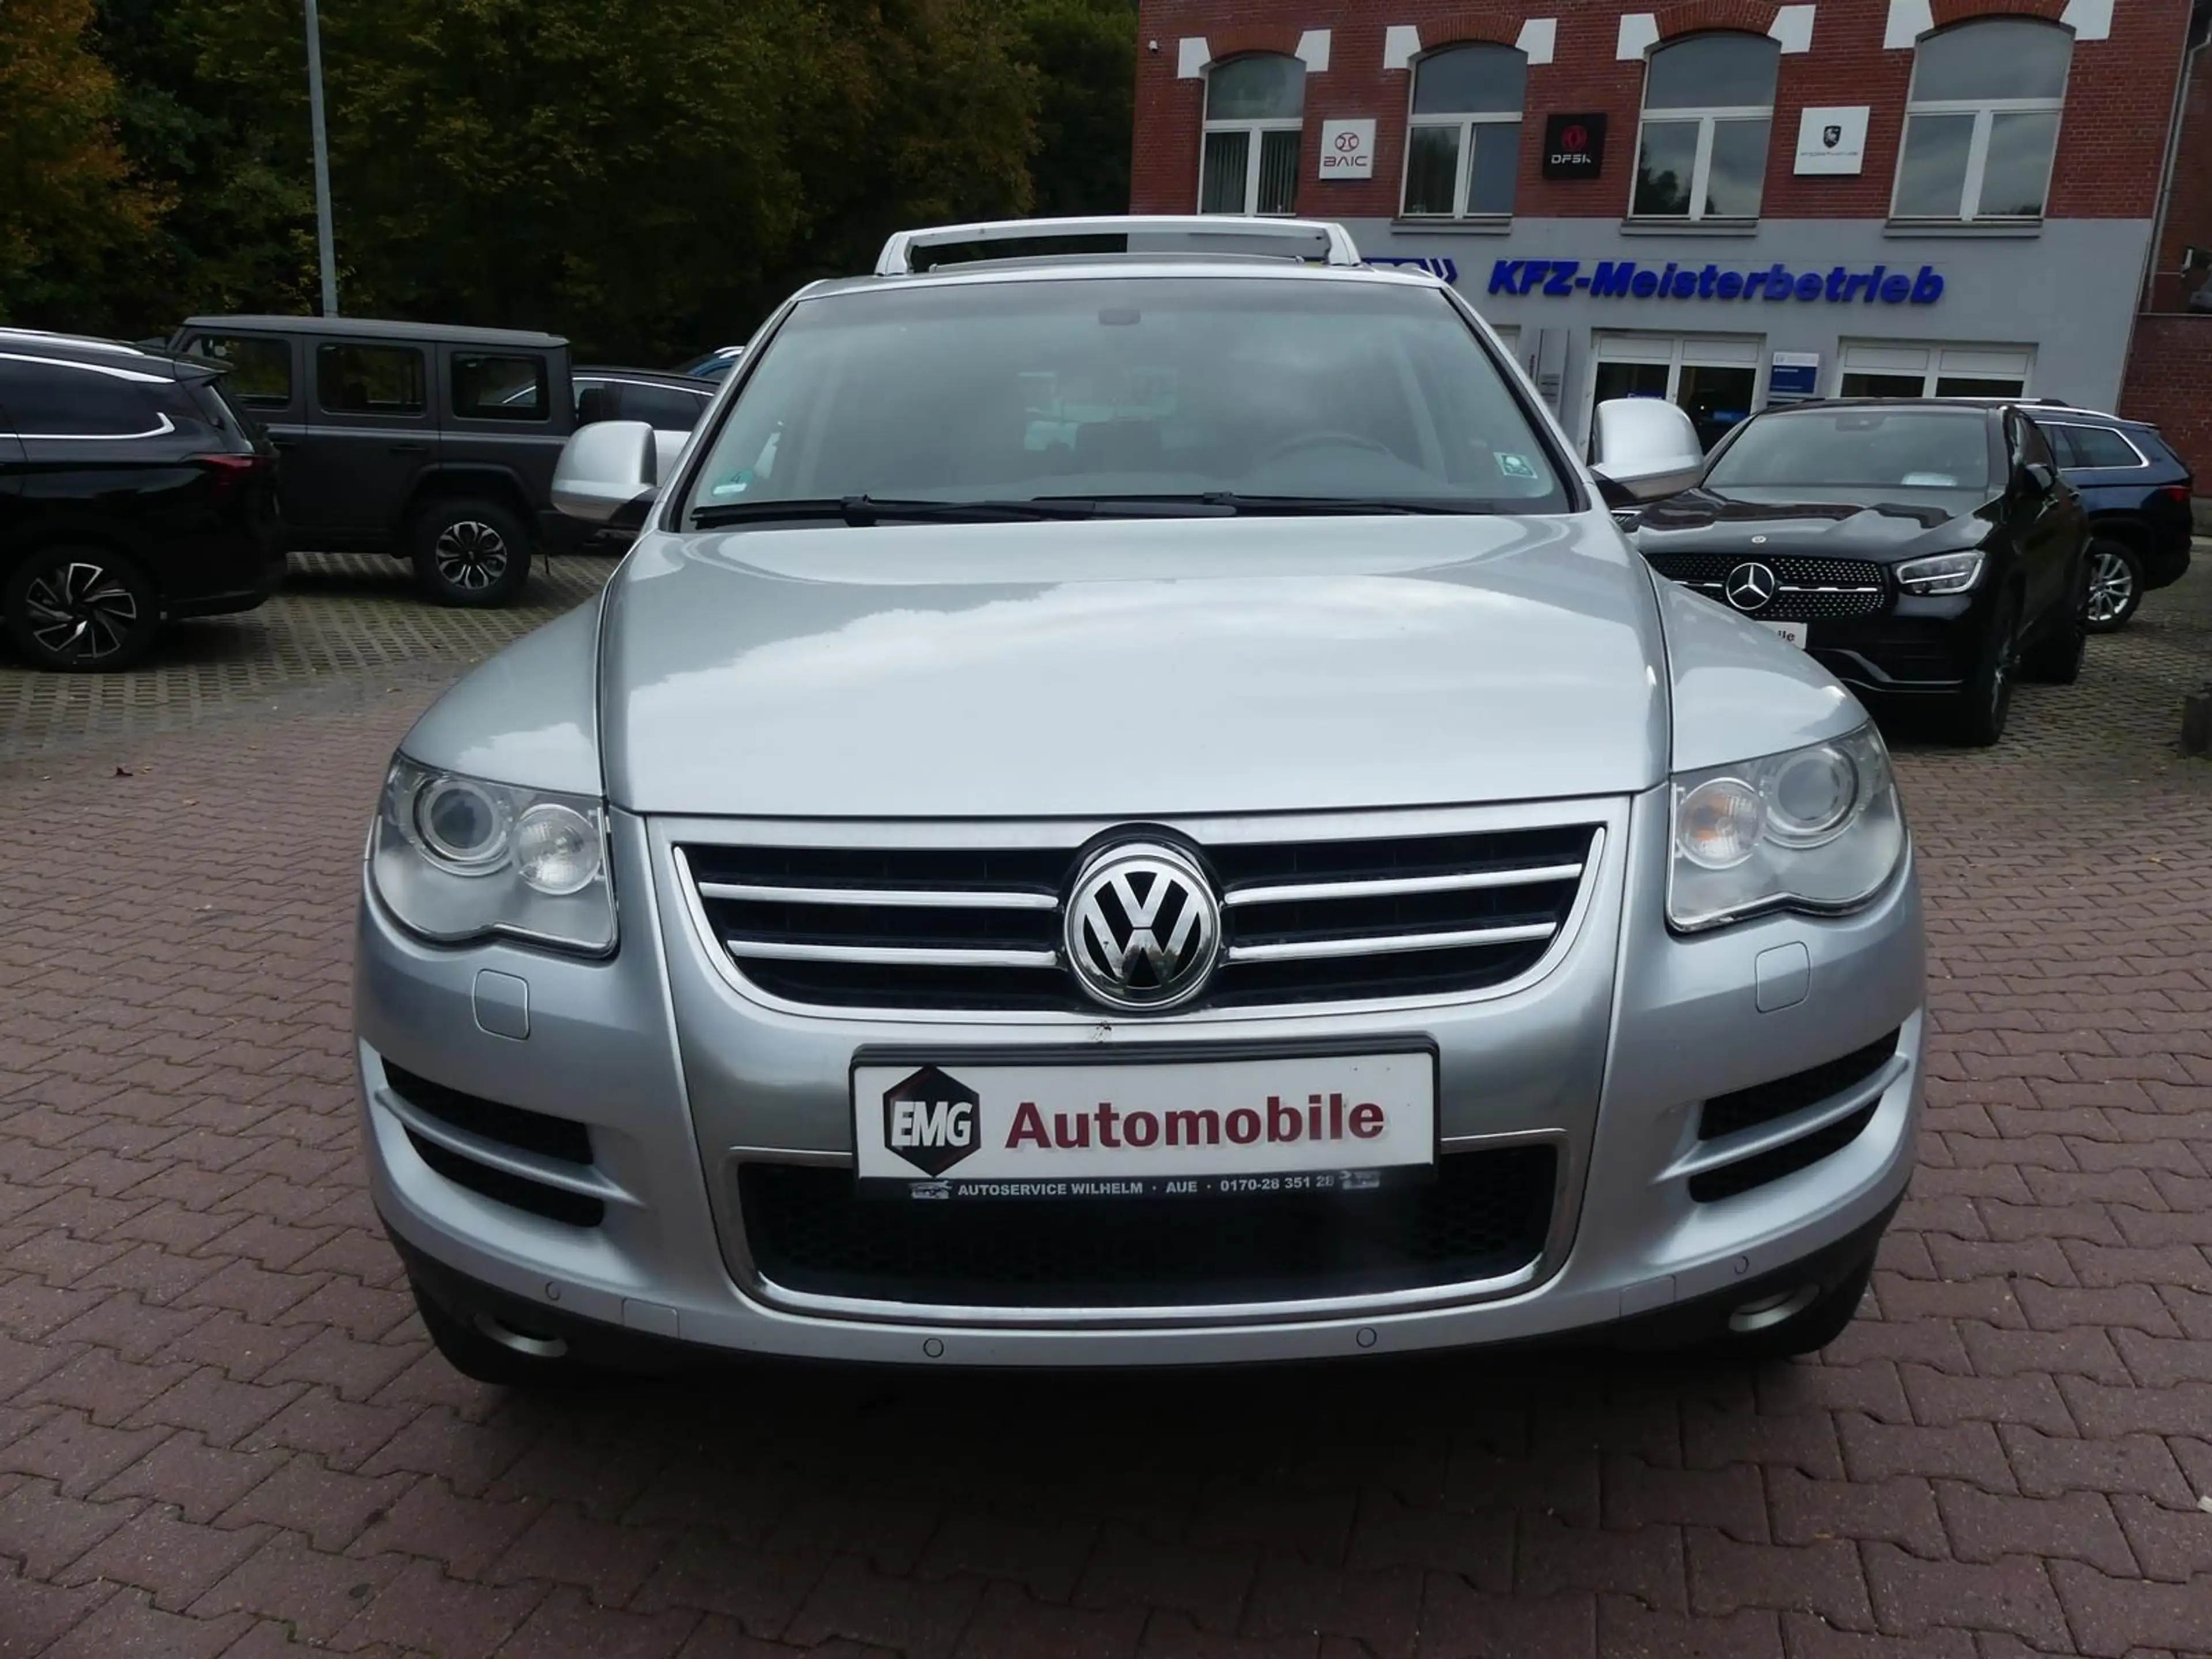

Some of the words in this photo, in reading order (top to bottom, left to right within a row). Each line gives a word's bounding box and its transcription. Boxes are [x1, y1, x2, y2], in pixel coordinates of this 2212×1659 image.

[1324, 156, 1368, 167] BAIC
[1487, 260, 1944, 304] KFZ-Meisterbetrieb
[1073, 861, 1213, 999] VW
[891, 1100, 974, 1147] EMG
[1005, 1093, 1384, 1149] Automobile
[957, 1183, 1067, 1196] AUTOSERVICE
[1071, 1182, 1143, 1195] WILHELM
[1166, 1181, 1198, 1194] AUE
[1220, 1177, 1280, 1191] 0170-28
[1284, 1175, 1310, 1189] 351
